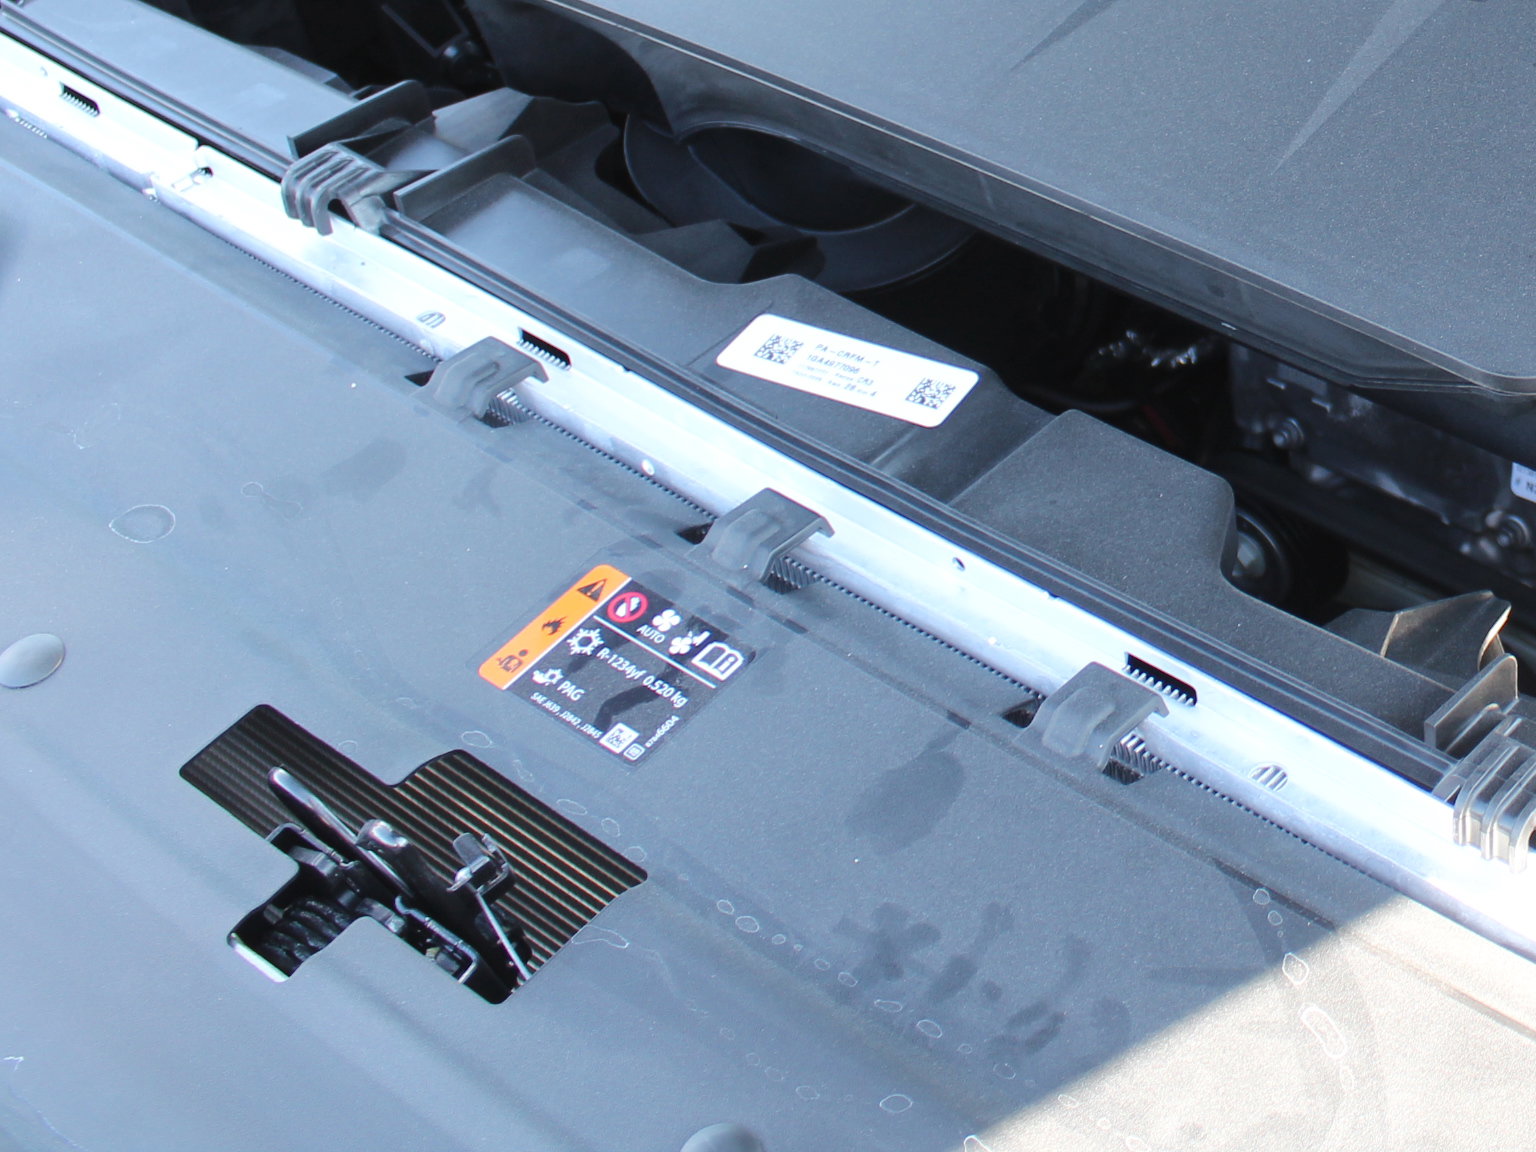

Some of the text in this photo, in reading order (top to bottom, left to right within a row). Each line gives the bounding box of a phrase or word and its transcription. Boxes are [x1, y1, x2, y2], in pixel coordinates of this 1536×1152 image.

[636, 623, 667, 645] AUTO
[595, 646, 689, 709] R-1234yf 0.520 kg
[530, 692, 547, 705] SAE
[557, 679, 587, 702] PAG
